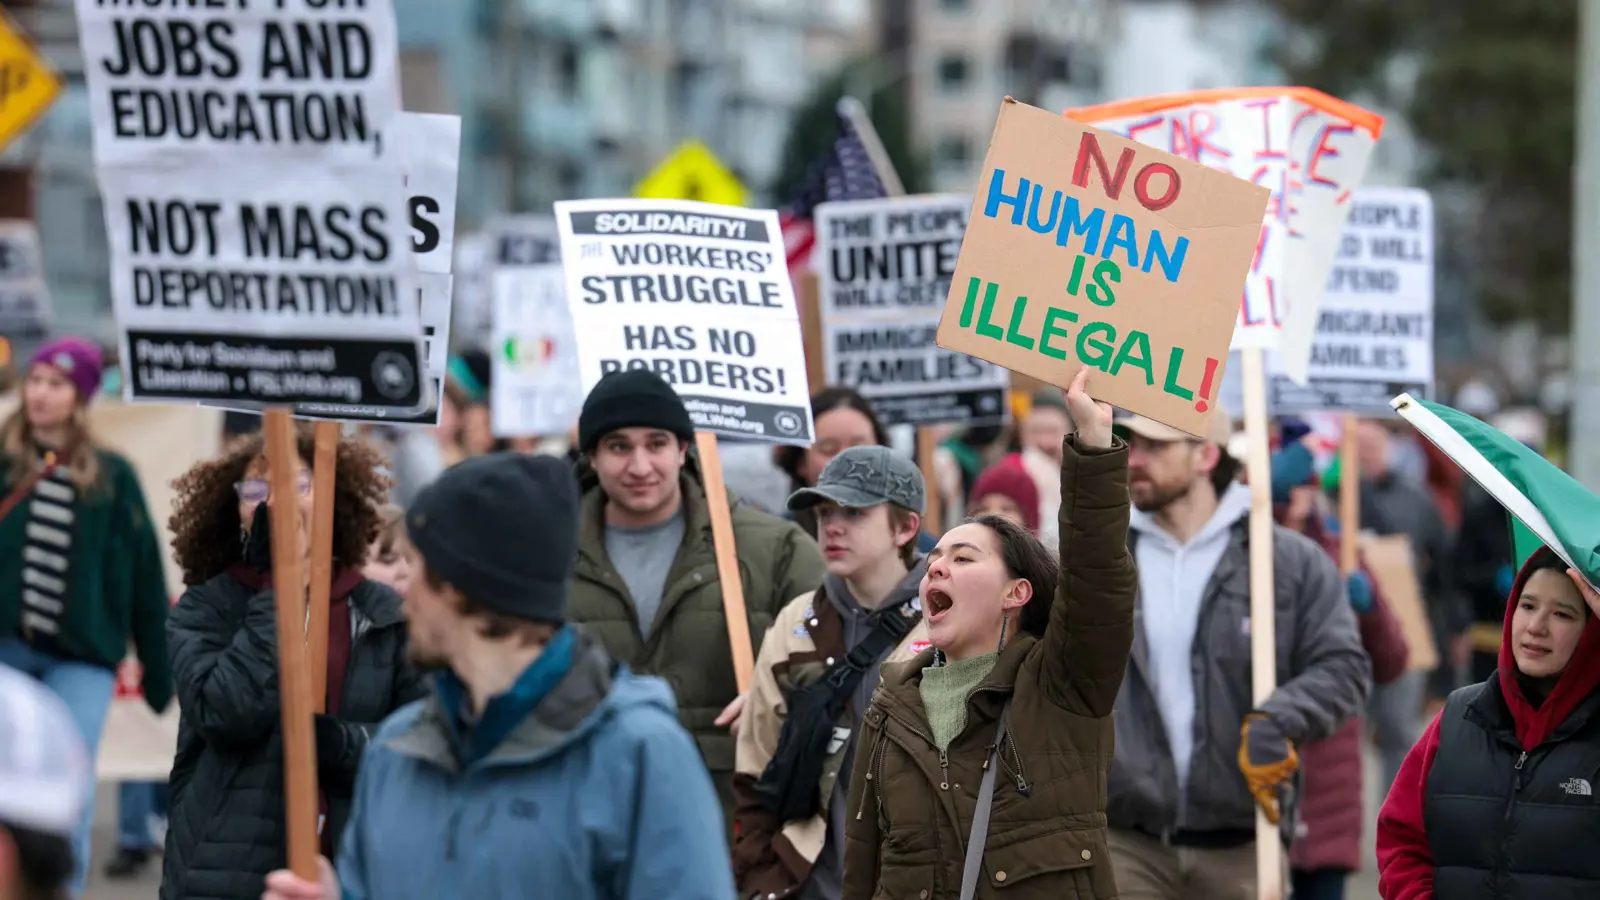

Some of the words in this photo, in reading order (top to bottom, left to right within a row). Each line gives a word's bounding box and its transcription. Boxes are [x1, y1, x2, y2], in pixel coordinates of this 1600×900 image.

[103, 18, 240, 79] JOBS
[261, 21, 372, 80] AND
[110, 88, 383, 157] EDUCATION,
[1071, 132, 1181, 211] NO
[127, 199, 222, 256] NOT
[240, 204, 390, 262] MASS
[594, 213, 747, 239] SOLIDARITY!
[830, 215, 872, 239] THE
[984, 168, 1190, 283] HUMAN
[611, 243, 772, 273] WORKERS'
[832, 239, 964, 283] UNITE
[133, 267, 400, 319] DEPORTATION!
[582, 274, 783, 308] STRUGGLE
[1066, 255, 1121, 307] IS
[136, 338, 184, 369] Party
[184, 341, 211, 366] for
[212, 342, 297, 370] Socialism
[298, 346, 336, 371] and
[623, 325, 697, 351] HAS
[708, 328, 757, 358] NO
[959, 276, 1219, 413] ILLEGAL!
[1309, 343, 1408, 369] AMILIES
[138, 366, 230, 392] Liberation
[838, 354, 985, 385] FAMILIES
[721, 404, 747, 418] and
